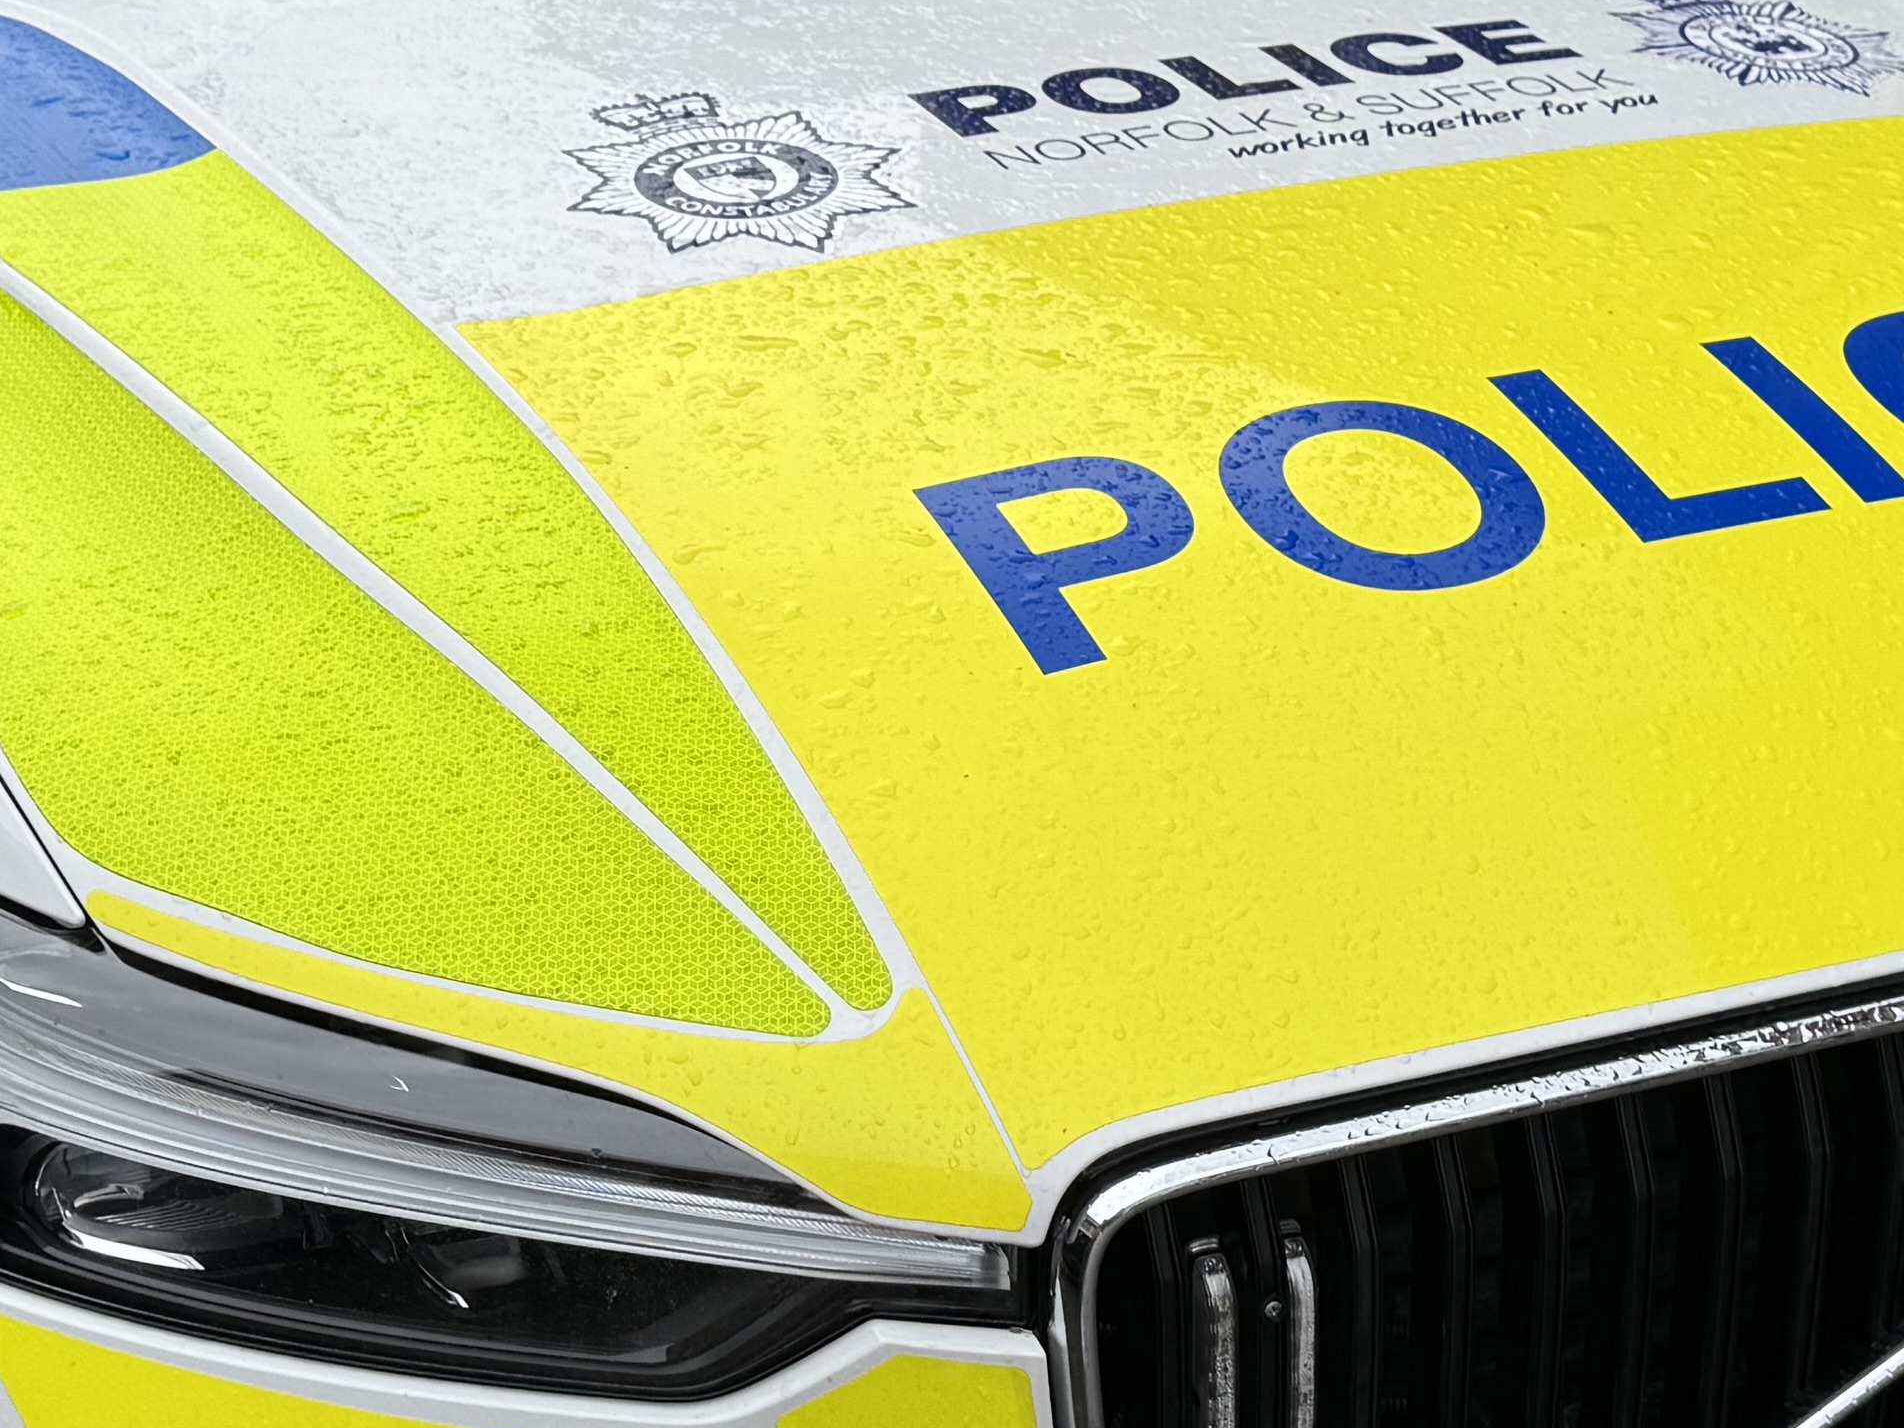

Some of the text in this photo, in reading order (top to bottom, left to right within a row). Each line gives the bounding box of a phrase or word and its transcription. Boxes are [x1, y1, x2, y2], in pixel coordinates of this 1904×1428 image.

[908, 19, 1585, 138] POLICE
[982, 67, 1635, 173] NORFOLK & SUFFOLK
[643, 140, 782, 176] NORFOLK
[1228, 91, 1658, 160] working together for you
